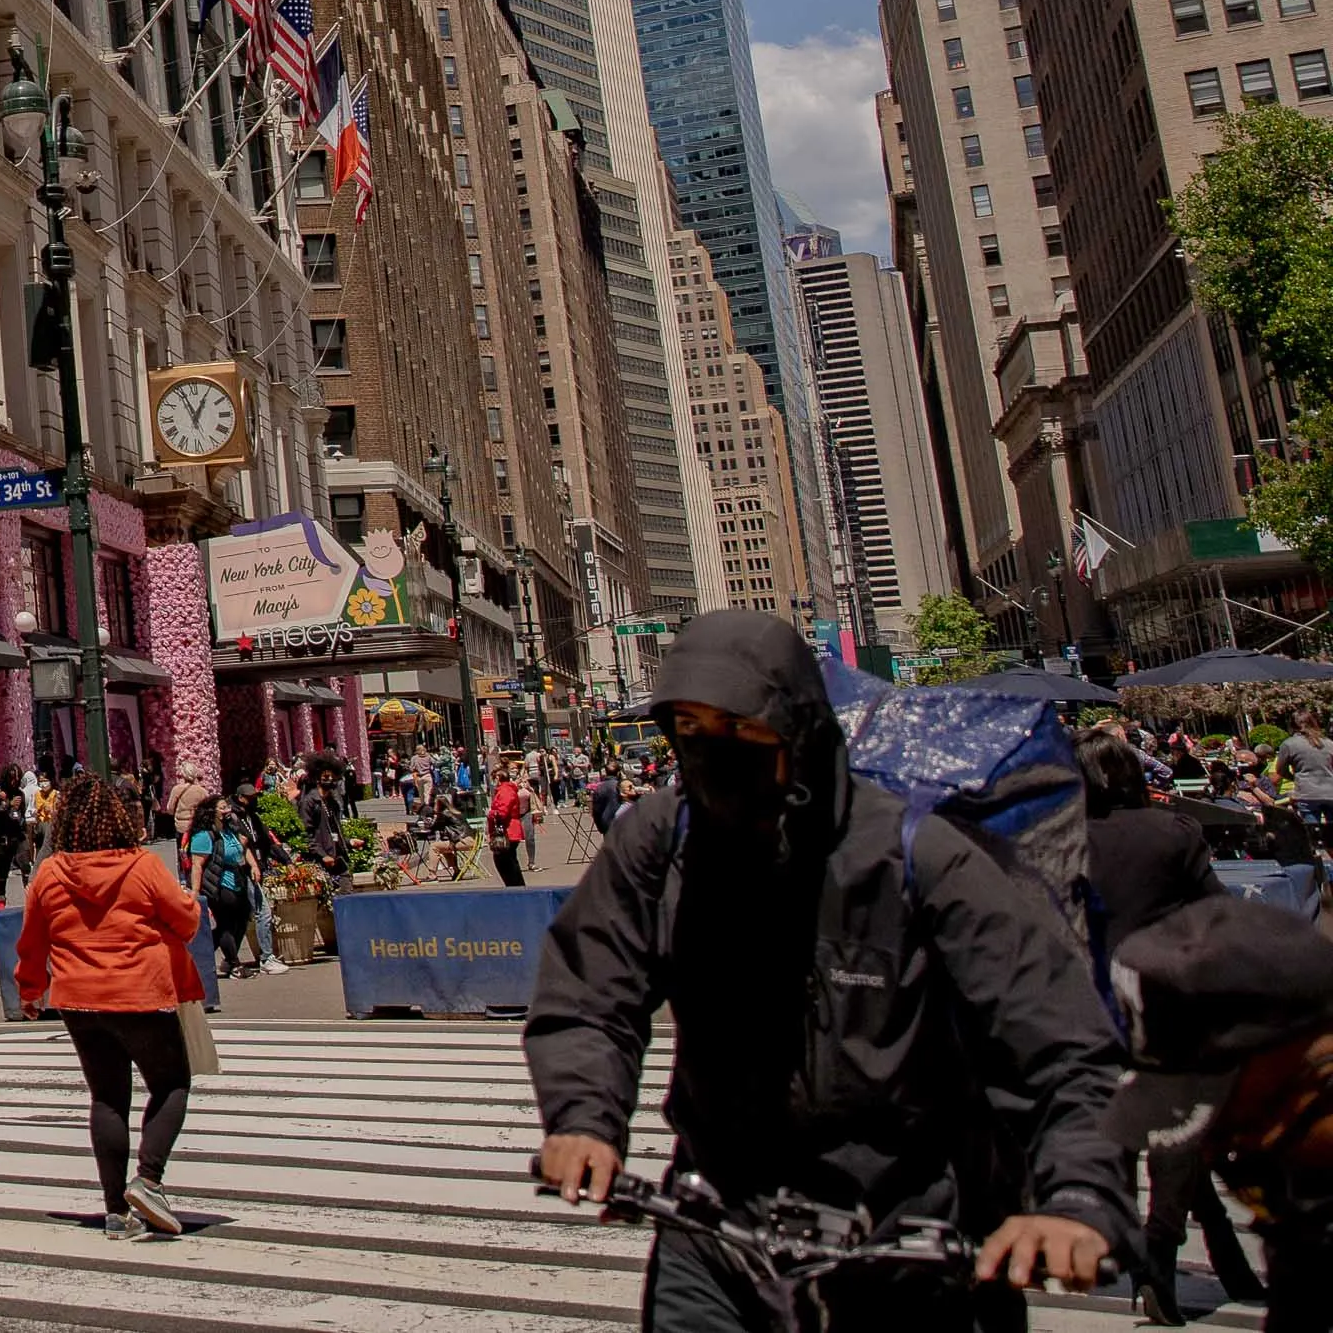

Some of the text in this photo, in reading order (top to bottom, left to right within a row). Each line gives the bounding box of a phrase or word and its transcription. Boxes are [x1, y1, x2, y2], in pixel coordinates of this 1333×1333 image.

[3, 480, 32, 502] 34th
[35, 480, 53, 498] St
[258, 546, 271, 554] TO
[220, 555, 319, 585] New York City
[260, 584, 285, 594] FROM
[253, 594, 300, 619] Macy's
[257, 618, 354, 650] macy's
[636, 625, 645, 633] 35
[370, 937, 523, 962] Herald Square
